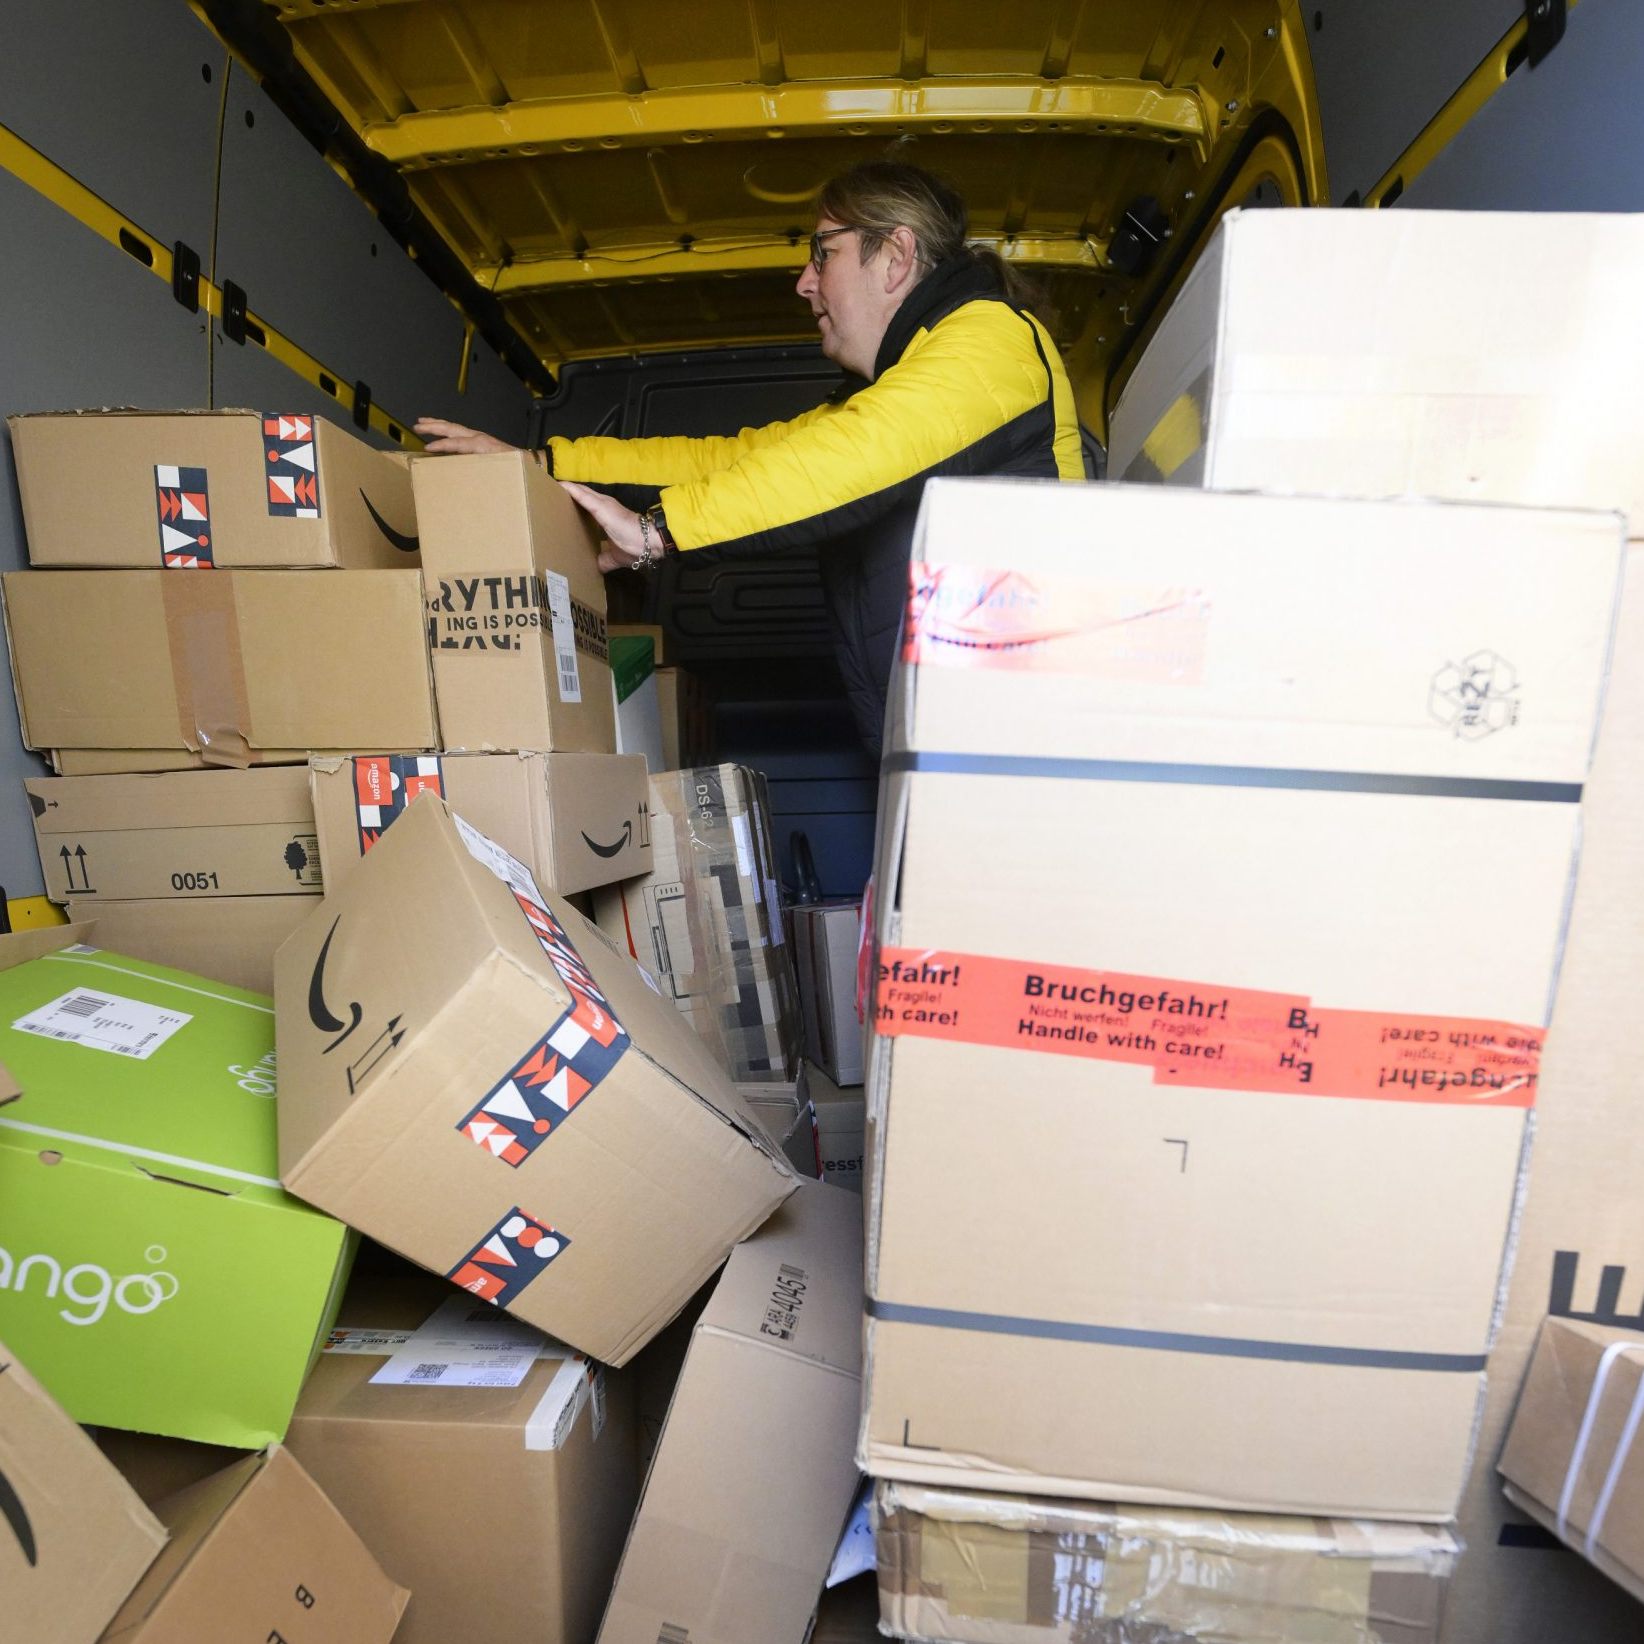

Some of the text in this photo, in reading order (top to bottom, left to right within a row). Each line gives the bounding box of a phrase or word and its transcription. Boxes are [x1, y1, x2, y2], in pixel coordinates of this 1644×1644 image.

[447, 616, 478, 631] ING
[484, 615, 499, 630] IS
[370, 763, 381, 800] amazon
[171, 872, 219, 891] 0051
[1024, 975, 1229, 1021] Bruchgefahr!
[902, 1008, 959, 1026] care!
[1029, 1004, 1210, 1038] Nicht werfen! Fragile!
[1018, 1019, 1225, 1060] Handle with care!
[770, 1276, 807, 1312] 4045
